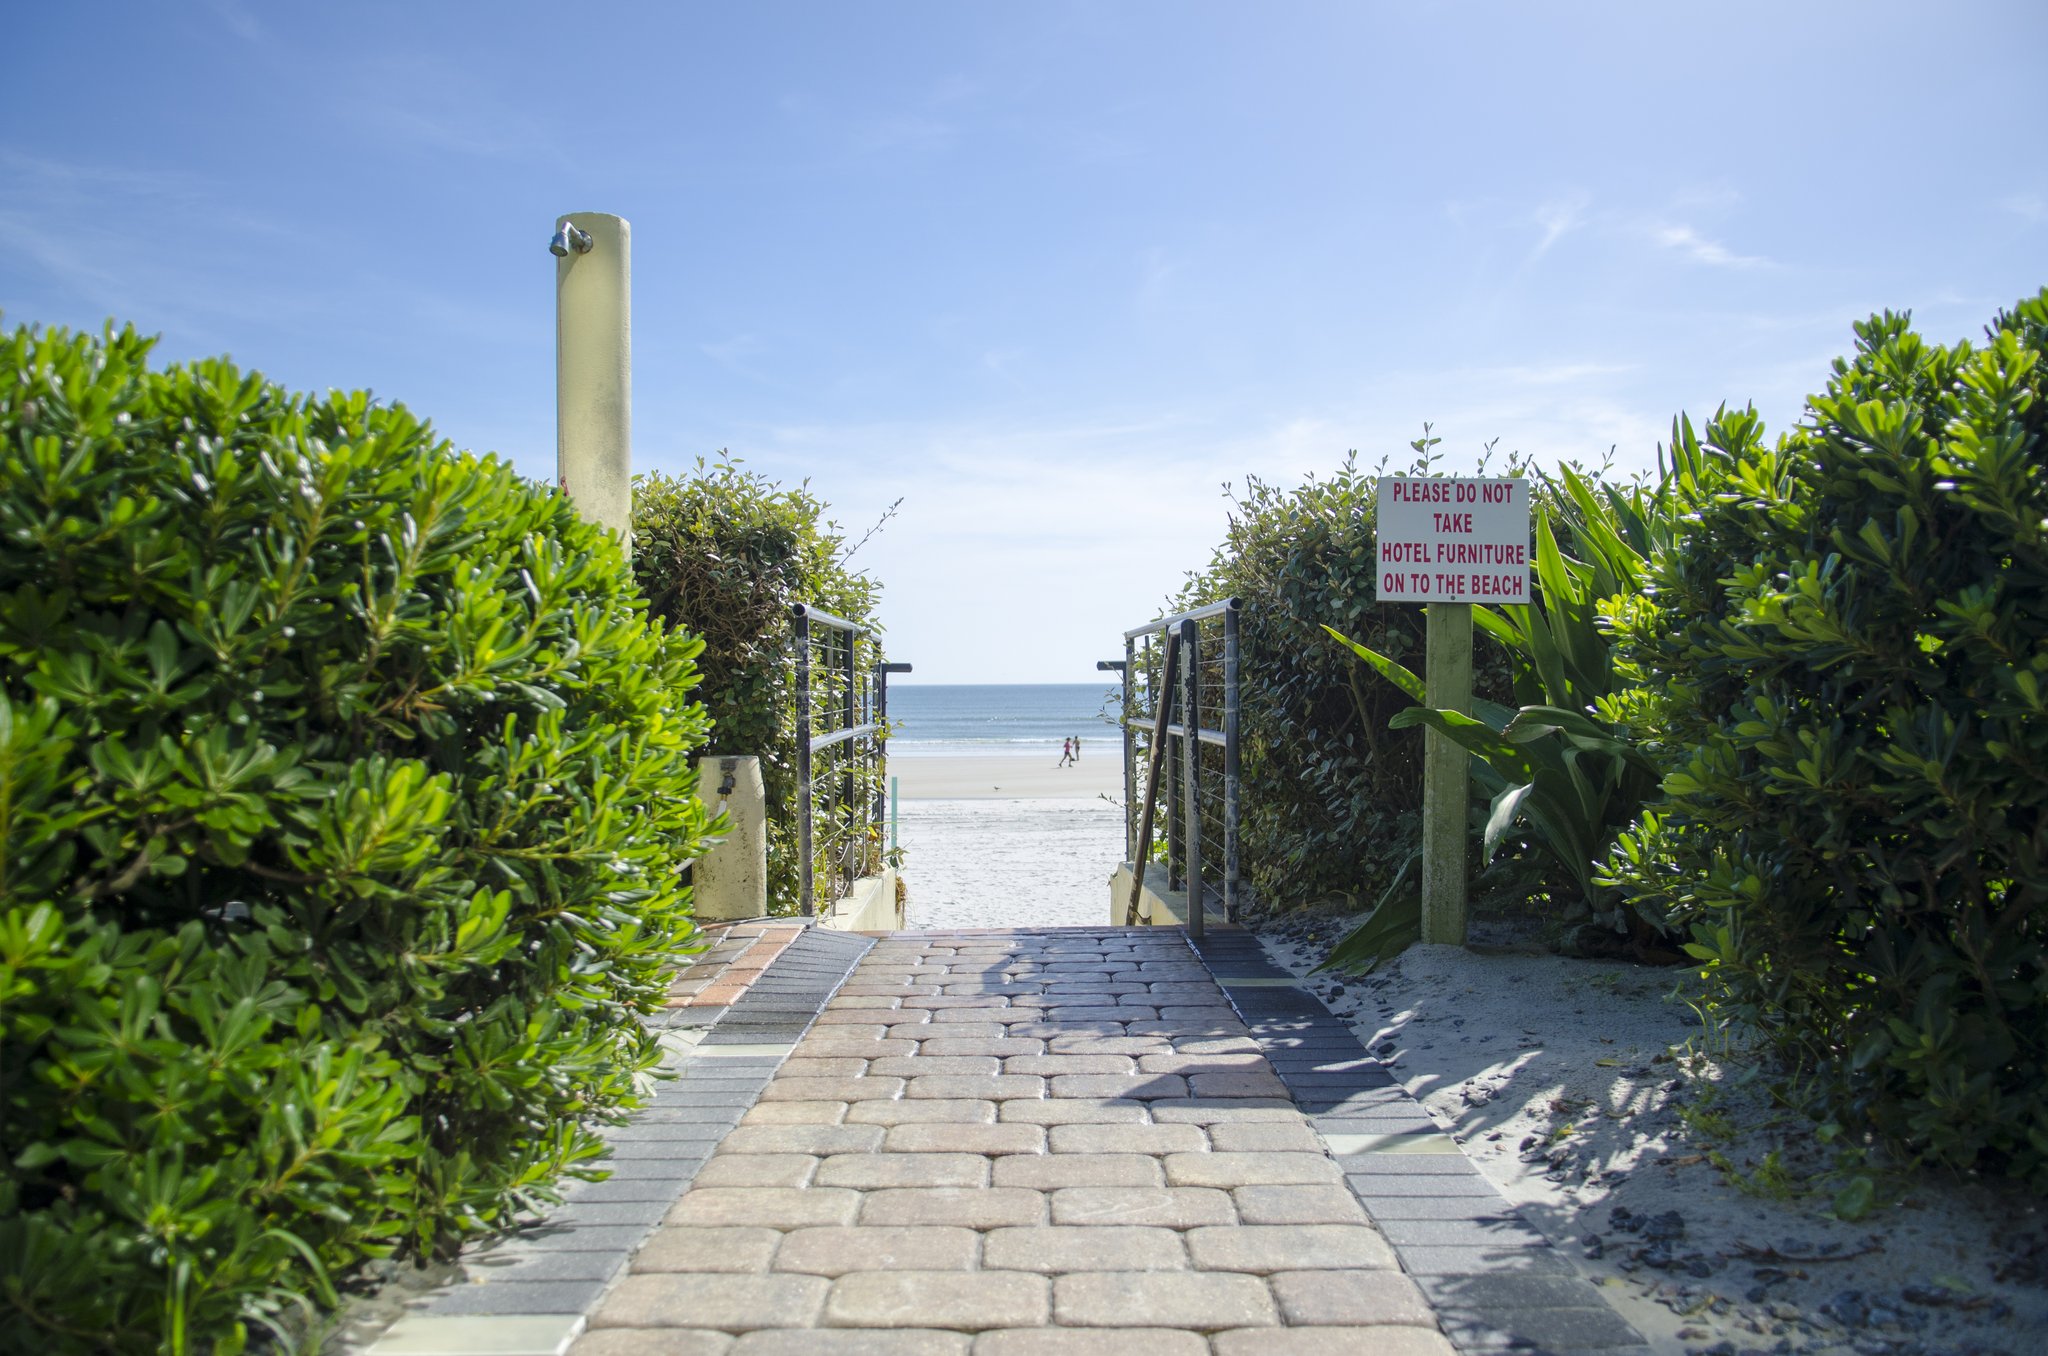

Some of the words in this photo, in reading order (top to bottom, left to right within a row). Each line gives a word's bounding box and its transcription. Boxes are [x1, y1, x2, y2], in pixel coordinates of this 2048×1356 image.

[1393, 482, 1450, 503] PLEASE
[1456, 483, 1477, 503] DO
[1482, 483, 1513, 504] NOT
[1433, 513, 1473, 533] TAKE
[1382, 542, 1431, 563] HOTEL
[1437, 543, 1525, 565] FURNITURE
[1383, 572, 1405, 593] ON
[1411, 573, 1430, 594] TO
[1435, 574, 1465, 594] THE
[1471, 574, 1522, 596] BEACH
